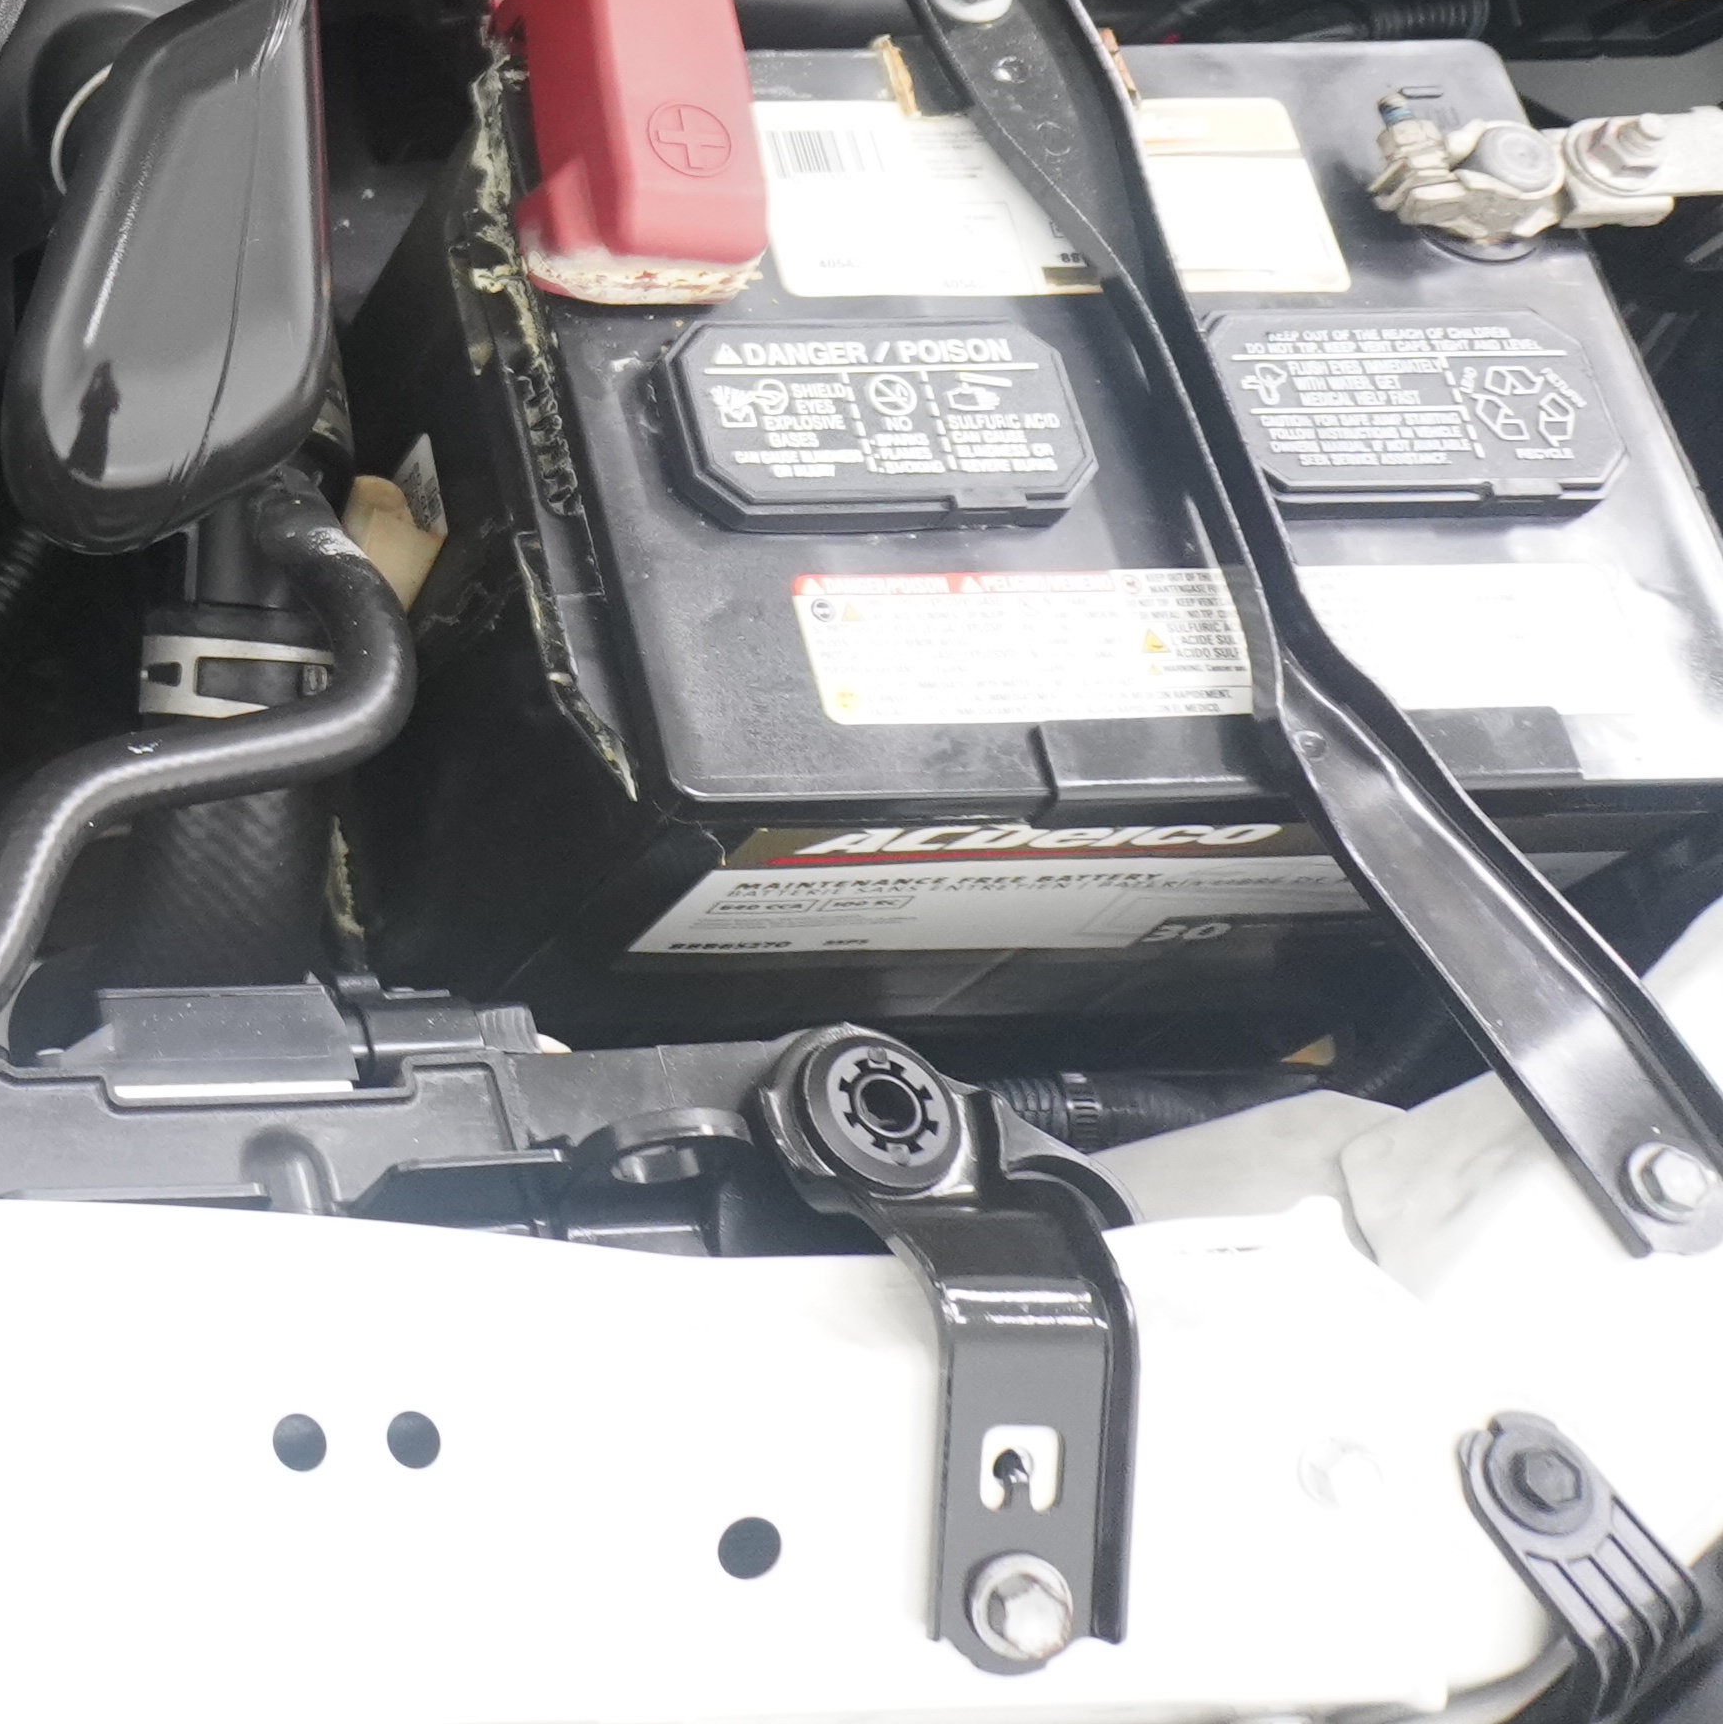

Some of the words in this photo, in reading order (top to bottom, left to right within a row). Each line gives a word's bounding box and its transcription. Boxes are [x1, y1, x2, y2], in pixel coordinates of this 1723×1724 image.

[1303, 330, 1329, 342] OUT
[1332, 329, 1351, 341] OF
[741, 342, 869, 365] DANGER
[898, 339, 1013, 363] POISON
[1245, 342, 1265, 355] DO
[1267, 342, 1296, 354] NOT
[791, 383, 847, 399] SHIELD
[1389, 391, 1422, 405] FAST
[796, 400, 836, 415] EYES
[763, 415, 846, 431] EXPLOSIVE
[884, 417, 913, 432] NO
[947, 414, 1021, 430] SULFURIC
[1024, 414, 1060, 429] ACID
[769, 433, 819, 448] GASES
[737, 877, 949, 890] MAINTENANCE
